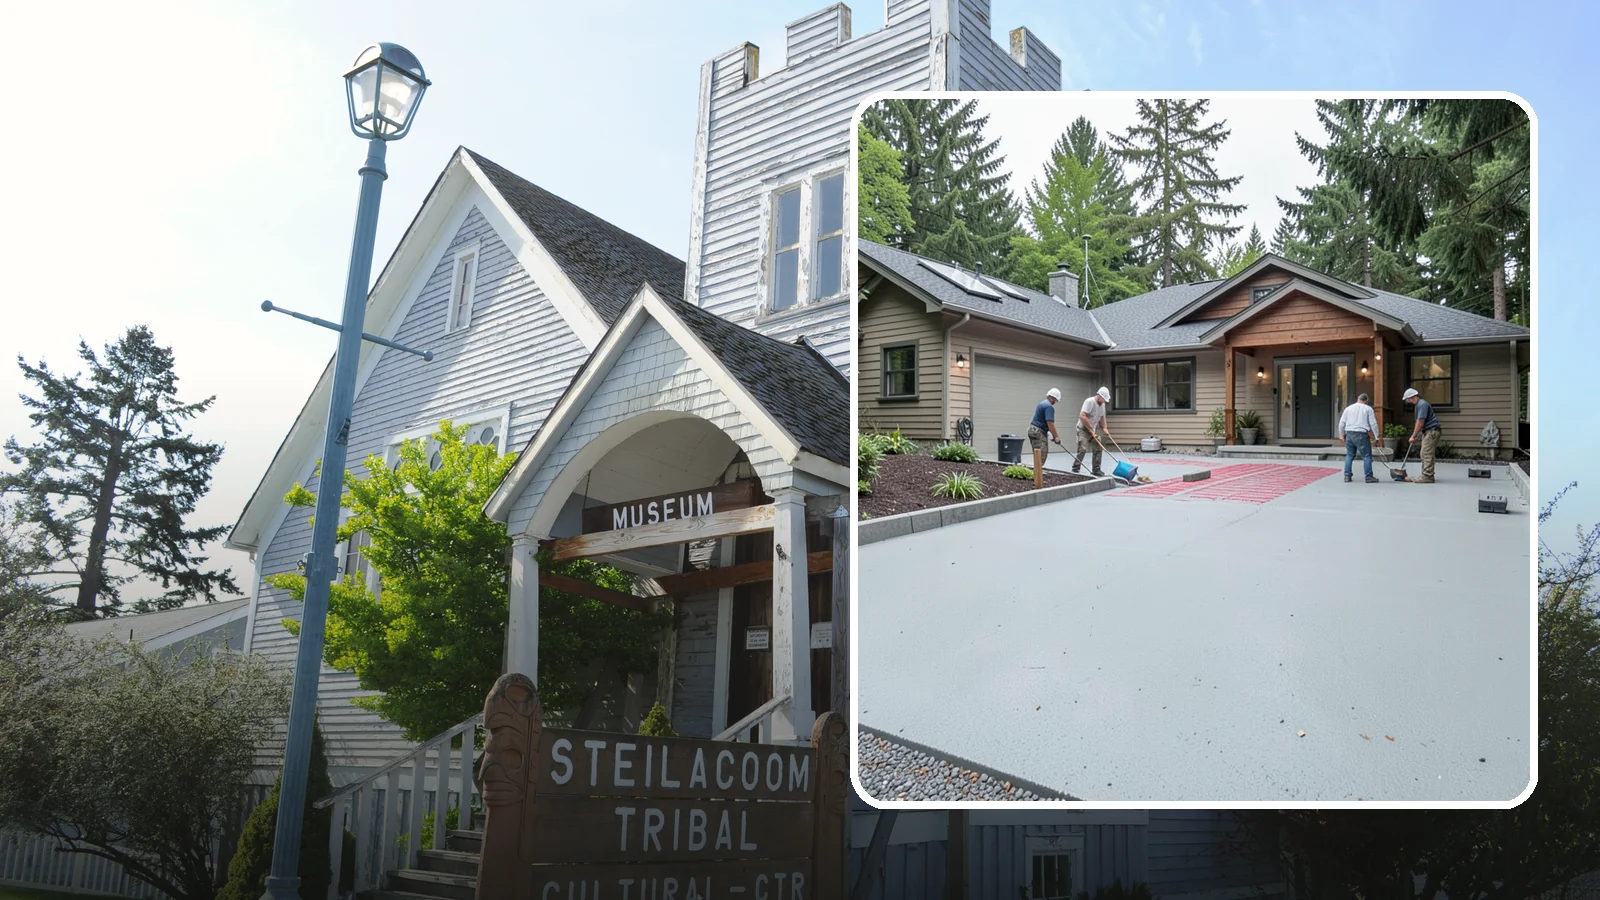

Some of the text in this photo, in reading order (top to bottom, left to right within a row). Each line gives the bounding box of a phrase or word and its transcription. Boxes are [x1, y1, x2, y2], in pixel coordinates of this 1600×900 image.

[613, 491, 713, 531] MUSEUM
[550, 738, 809, 792] STEILACOOM
[615, 807, 757, 852] TRIBAL
